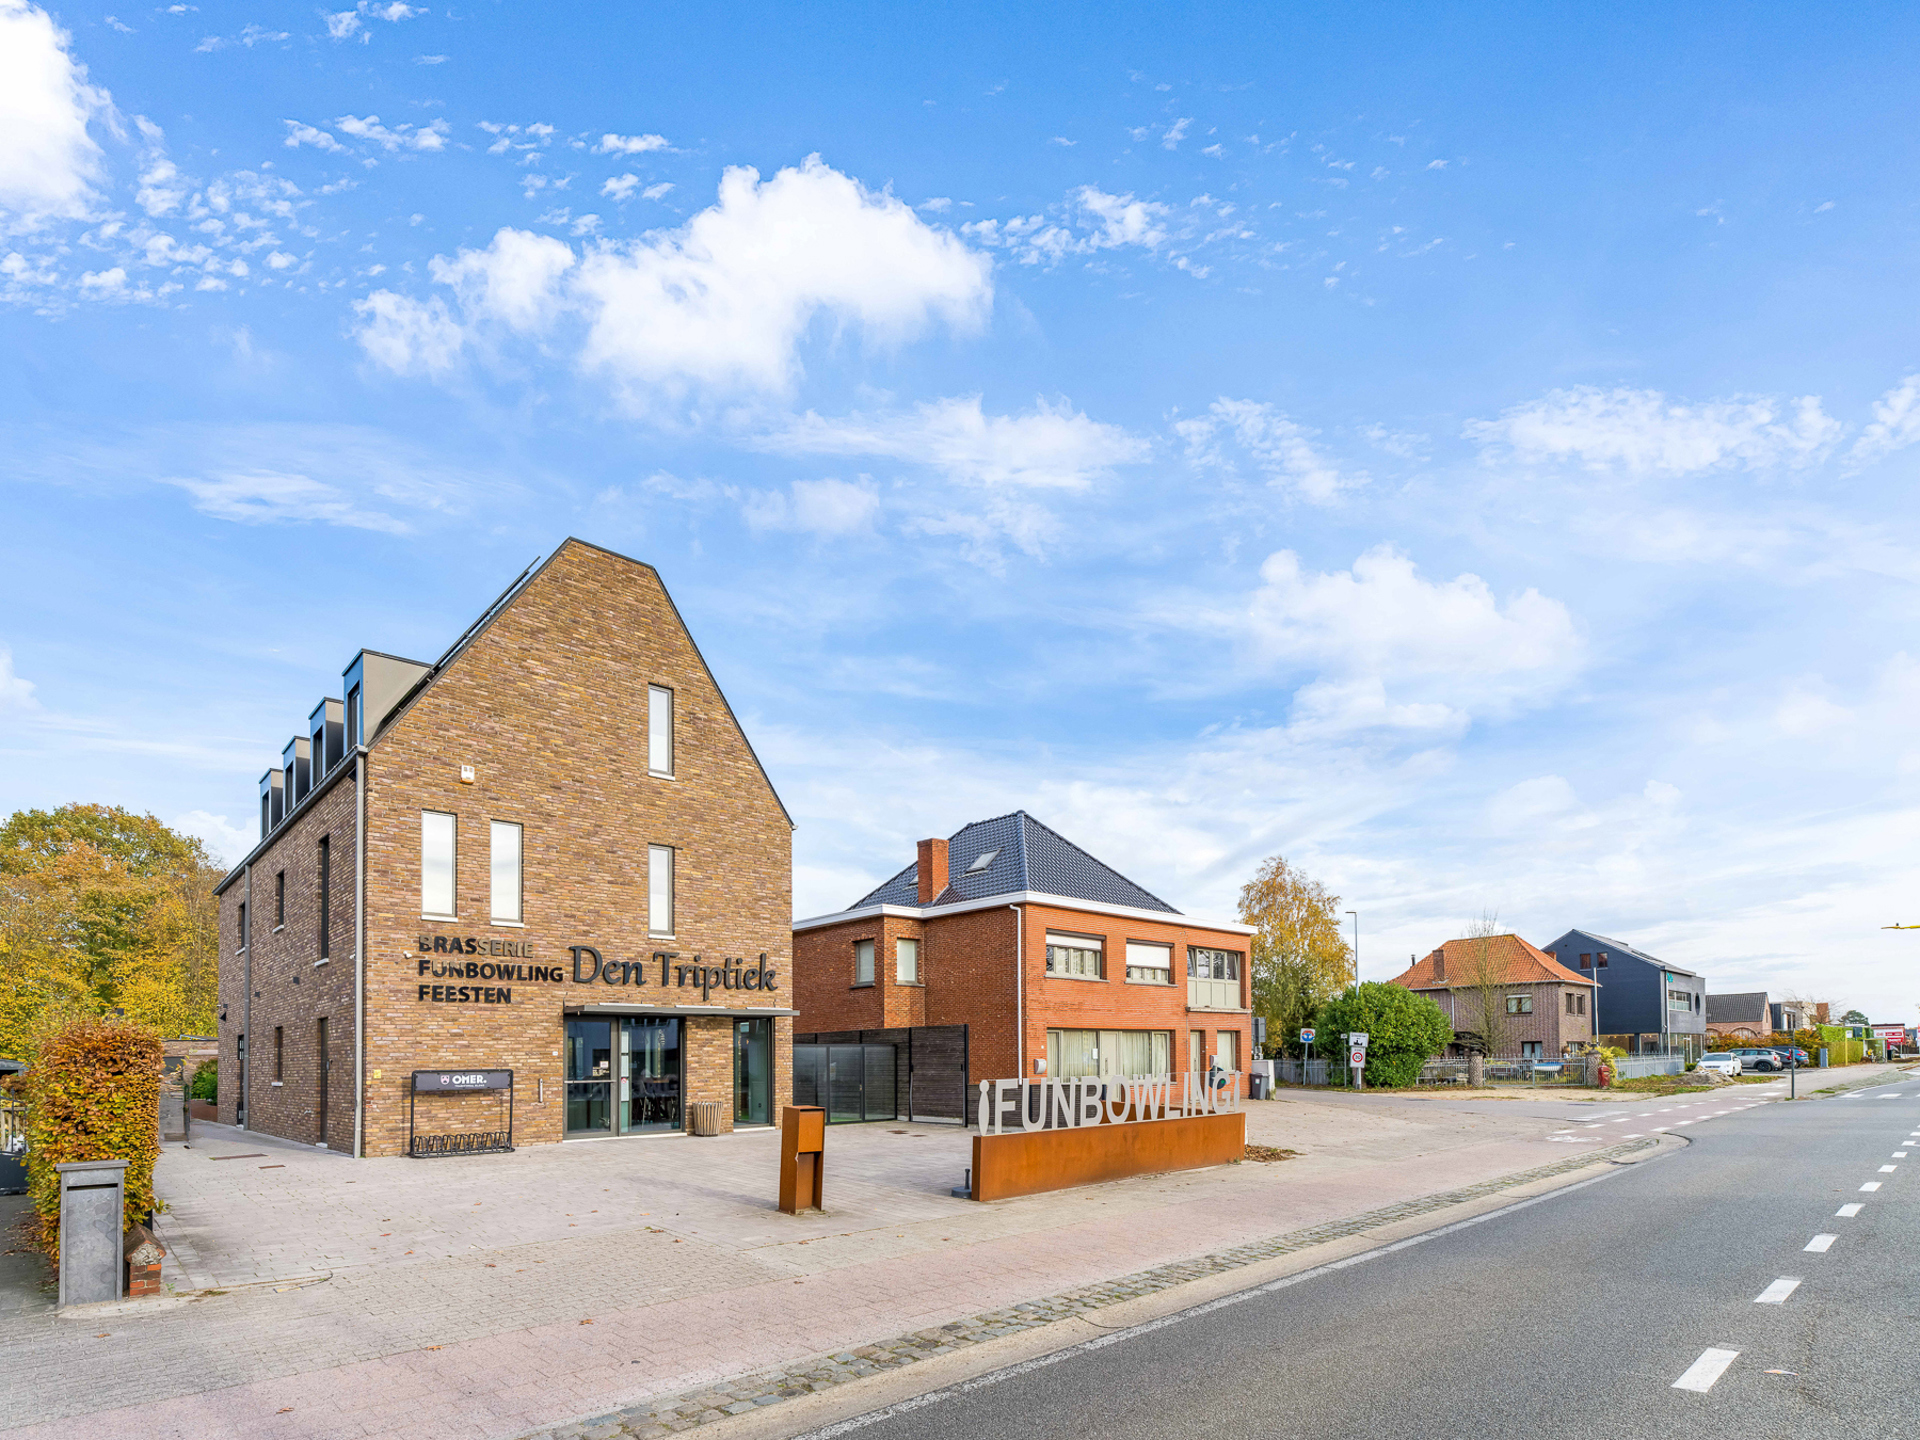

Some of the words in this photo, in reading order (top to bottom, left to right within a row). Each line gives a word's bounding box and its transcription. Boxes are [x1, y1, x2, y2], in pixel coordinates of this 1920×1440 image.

[418, 935, 533, 958] BRASSERIE
[418, 959, 563, 982] FUNBOWLING
[569, 945, 647, 985] Den
[653, 952, 778, 1001] Triptiek
[418, 984, 511, 1004] FEESTEN
